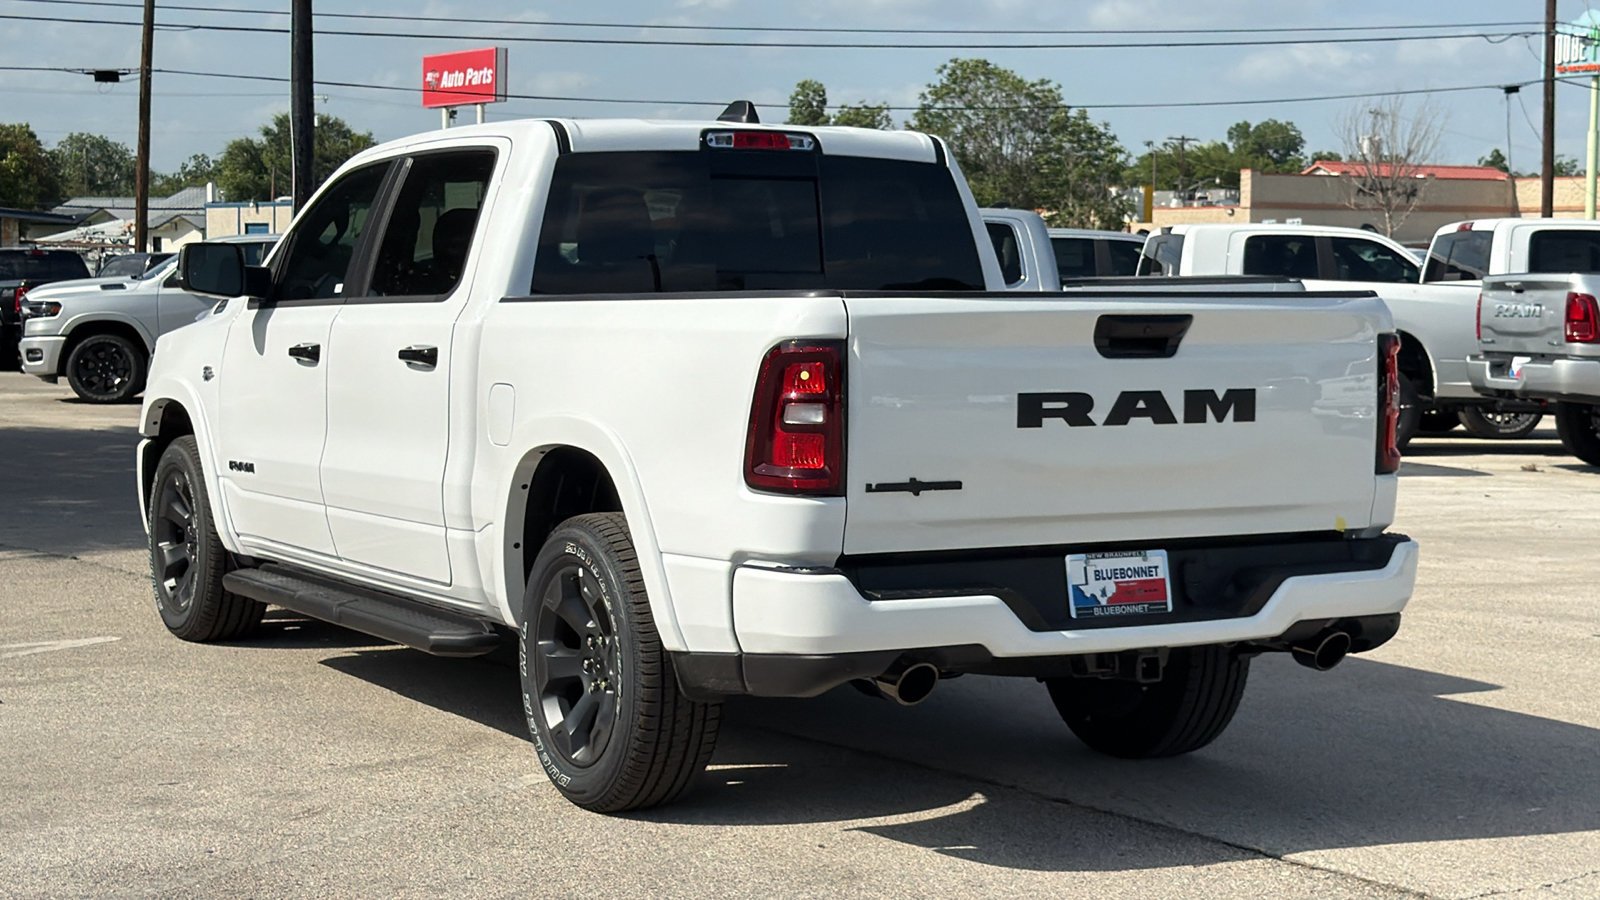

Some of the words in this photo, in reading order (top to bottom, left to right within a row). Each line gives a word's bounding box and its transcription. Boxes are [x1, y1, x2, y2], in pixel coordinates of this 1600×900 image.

[440, 70, 465, 89] Auto
[465, 67, 493, 86] Parts
[1494, 303, 1542, 318] RAM
[1017, 388, 1256, 428] RAM
[228, 460, 255, 474] RAM
[1093, 565, 1159, 581] BLUEBONNET
[1093, 604, 1149, 616] BLUEBONNET
